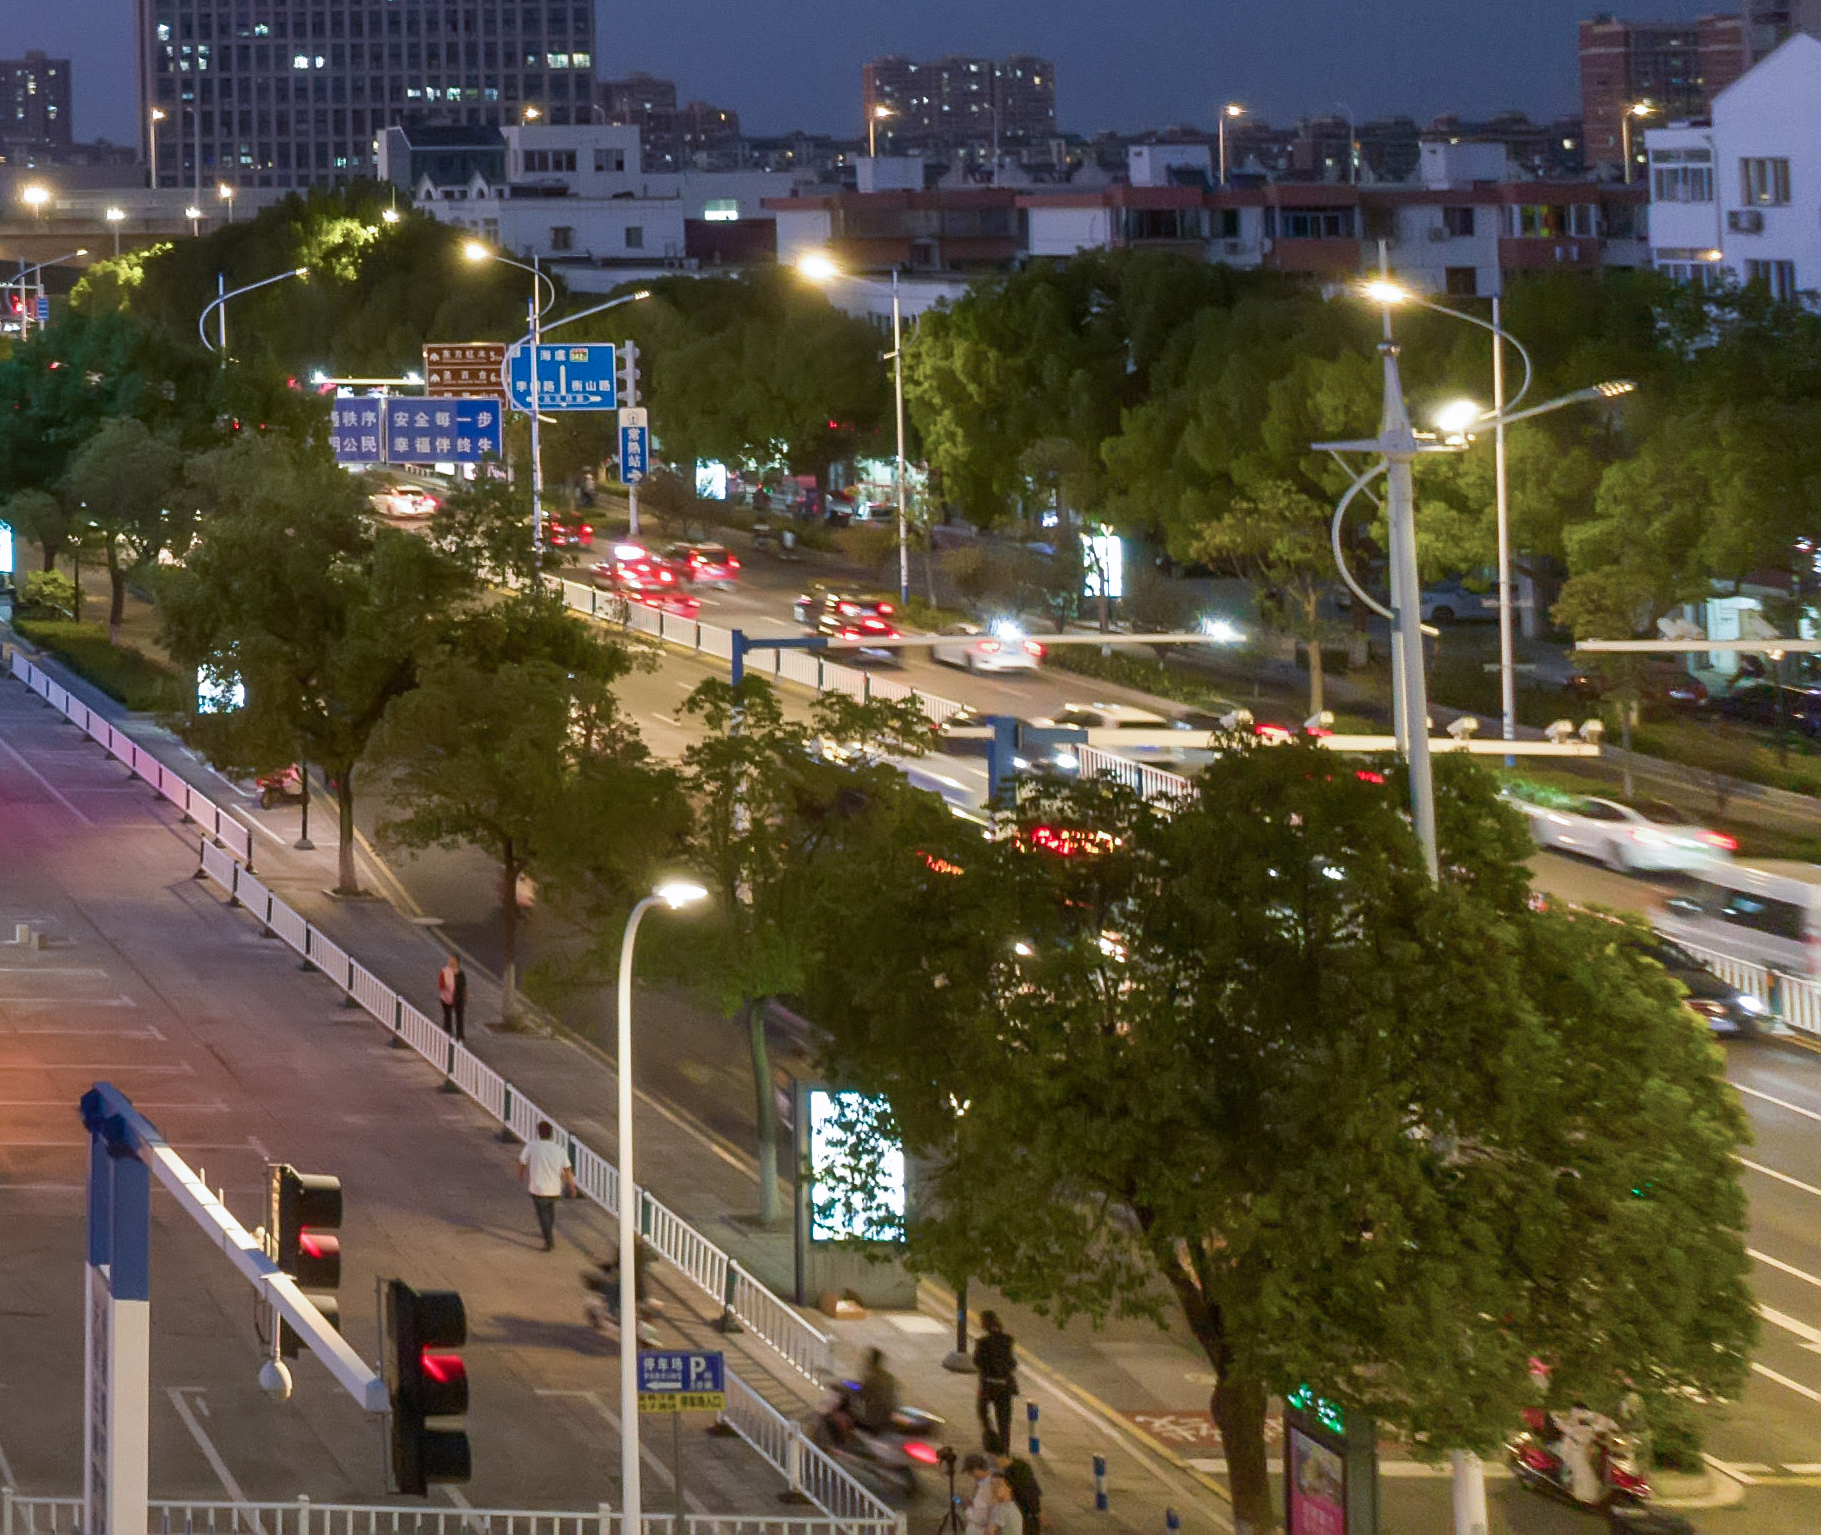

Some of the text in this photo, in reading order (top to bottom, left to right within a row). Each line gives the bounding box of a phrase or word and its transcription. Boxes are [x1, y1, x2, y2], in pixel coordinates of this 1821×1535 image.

[394, 411, 493, 428] 安全每一步
[394, 436, 493, 454] 幸福伴终生
[690, 1356, 706, 1380] P
